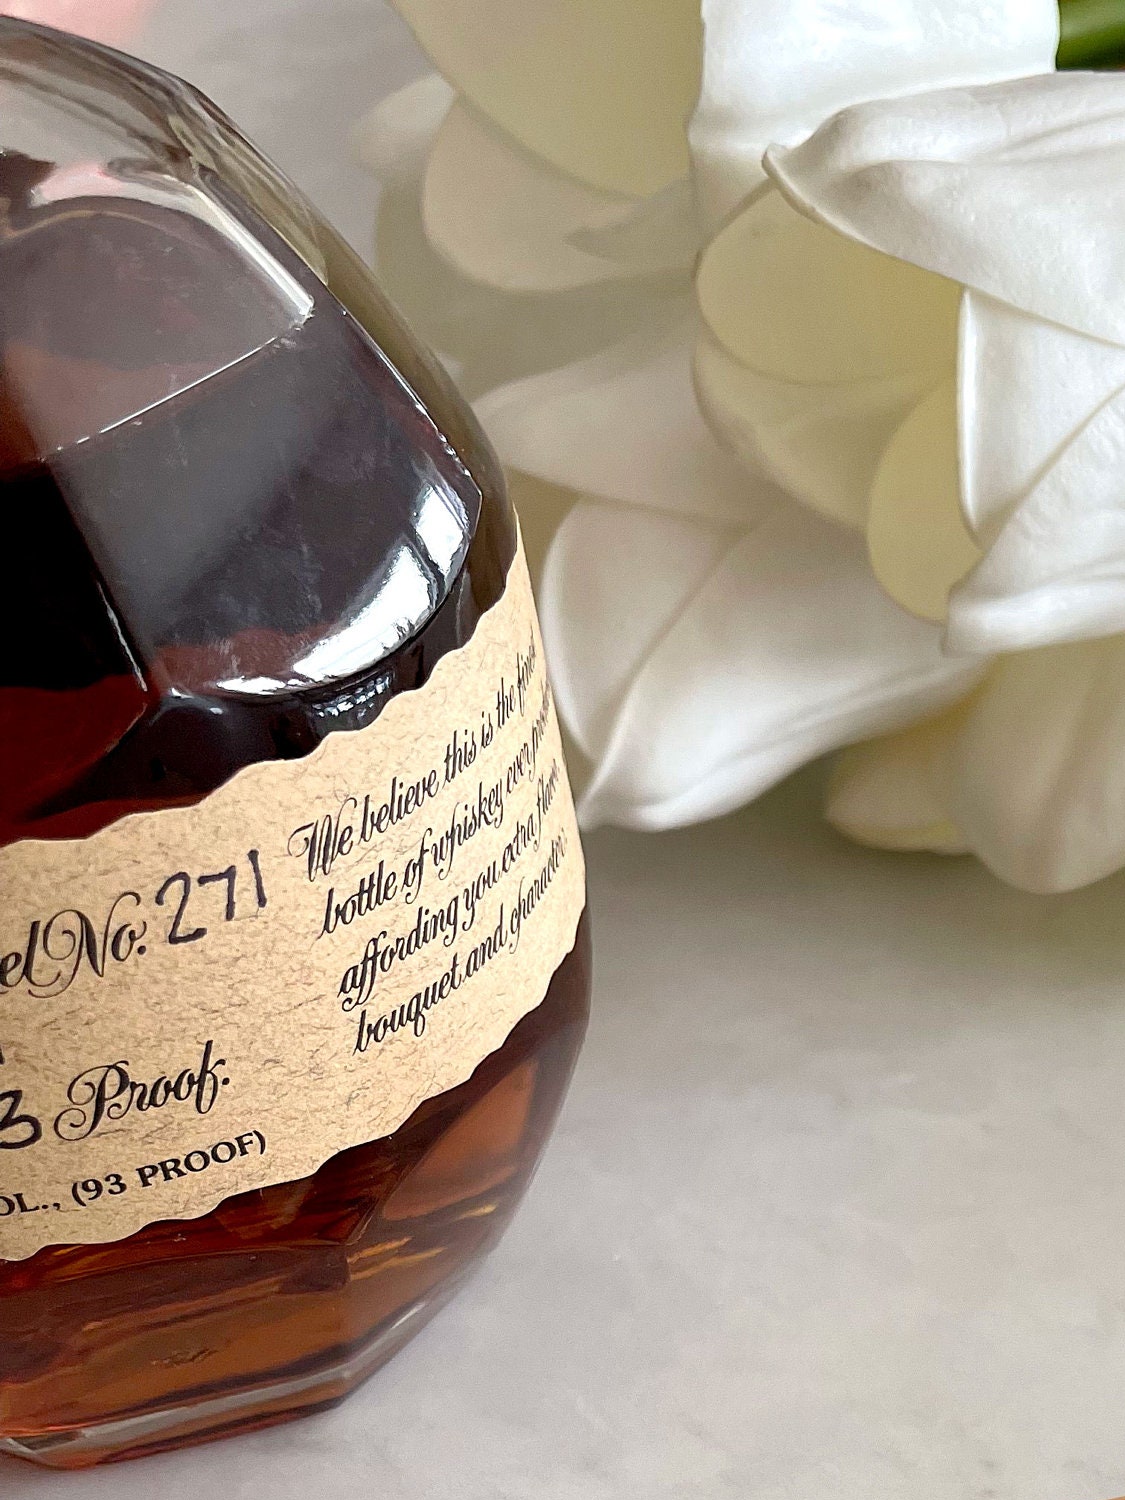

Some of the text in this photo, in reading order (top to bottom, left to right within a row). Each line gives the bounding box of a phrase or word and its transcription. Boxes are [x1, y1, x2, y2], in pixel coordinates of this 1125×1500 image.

[288, 797, 358, 882] We
[359, 776, 438, 846] believe
[442, 730, 477, 785] this
[480, 711, 494, 750] is
[496, 677, 516, 729] the
[317, 743, 531, 940] bottle of whiskey ever
[155, 849, 268, 945] 271
[337, 895, 459, 1012] affording
[462, 860, 501, 931] you
[502, 813, 537, 874] extra
[352, 952, 463, 1056] bouquet
[462, 903, 508, 983] and
[71, 1173, 127, 1206] (93
[136, 1130, 267, 1188] PROOF)
